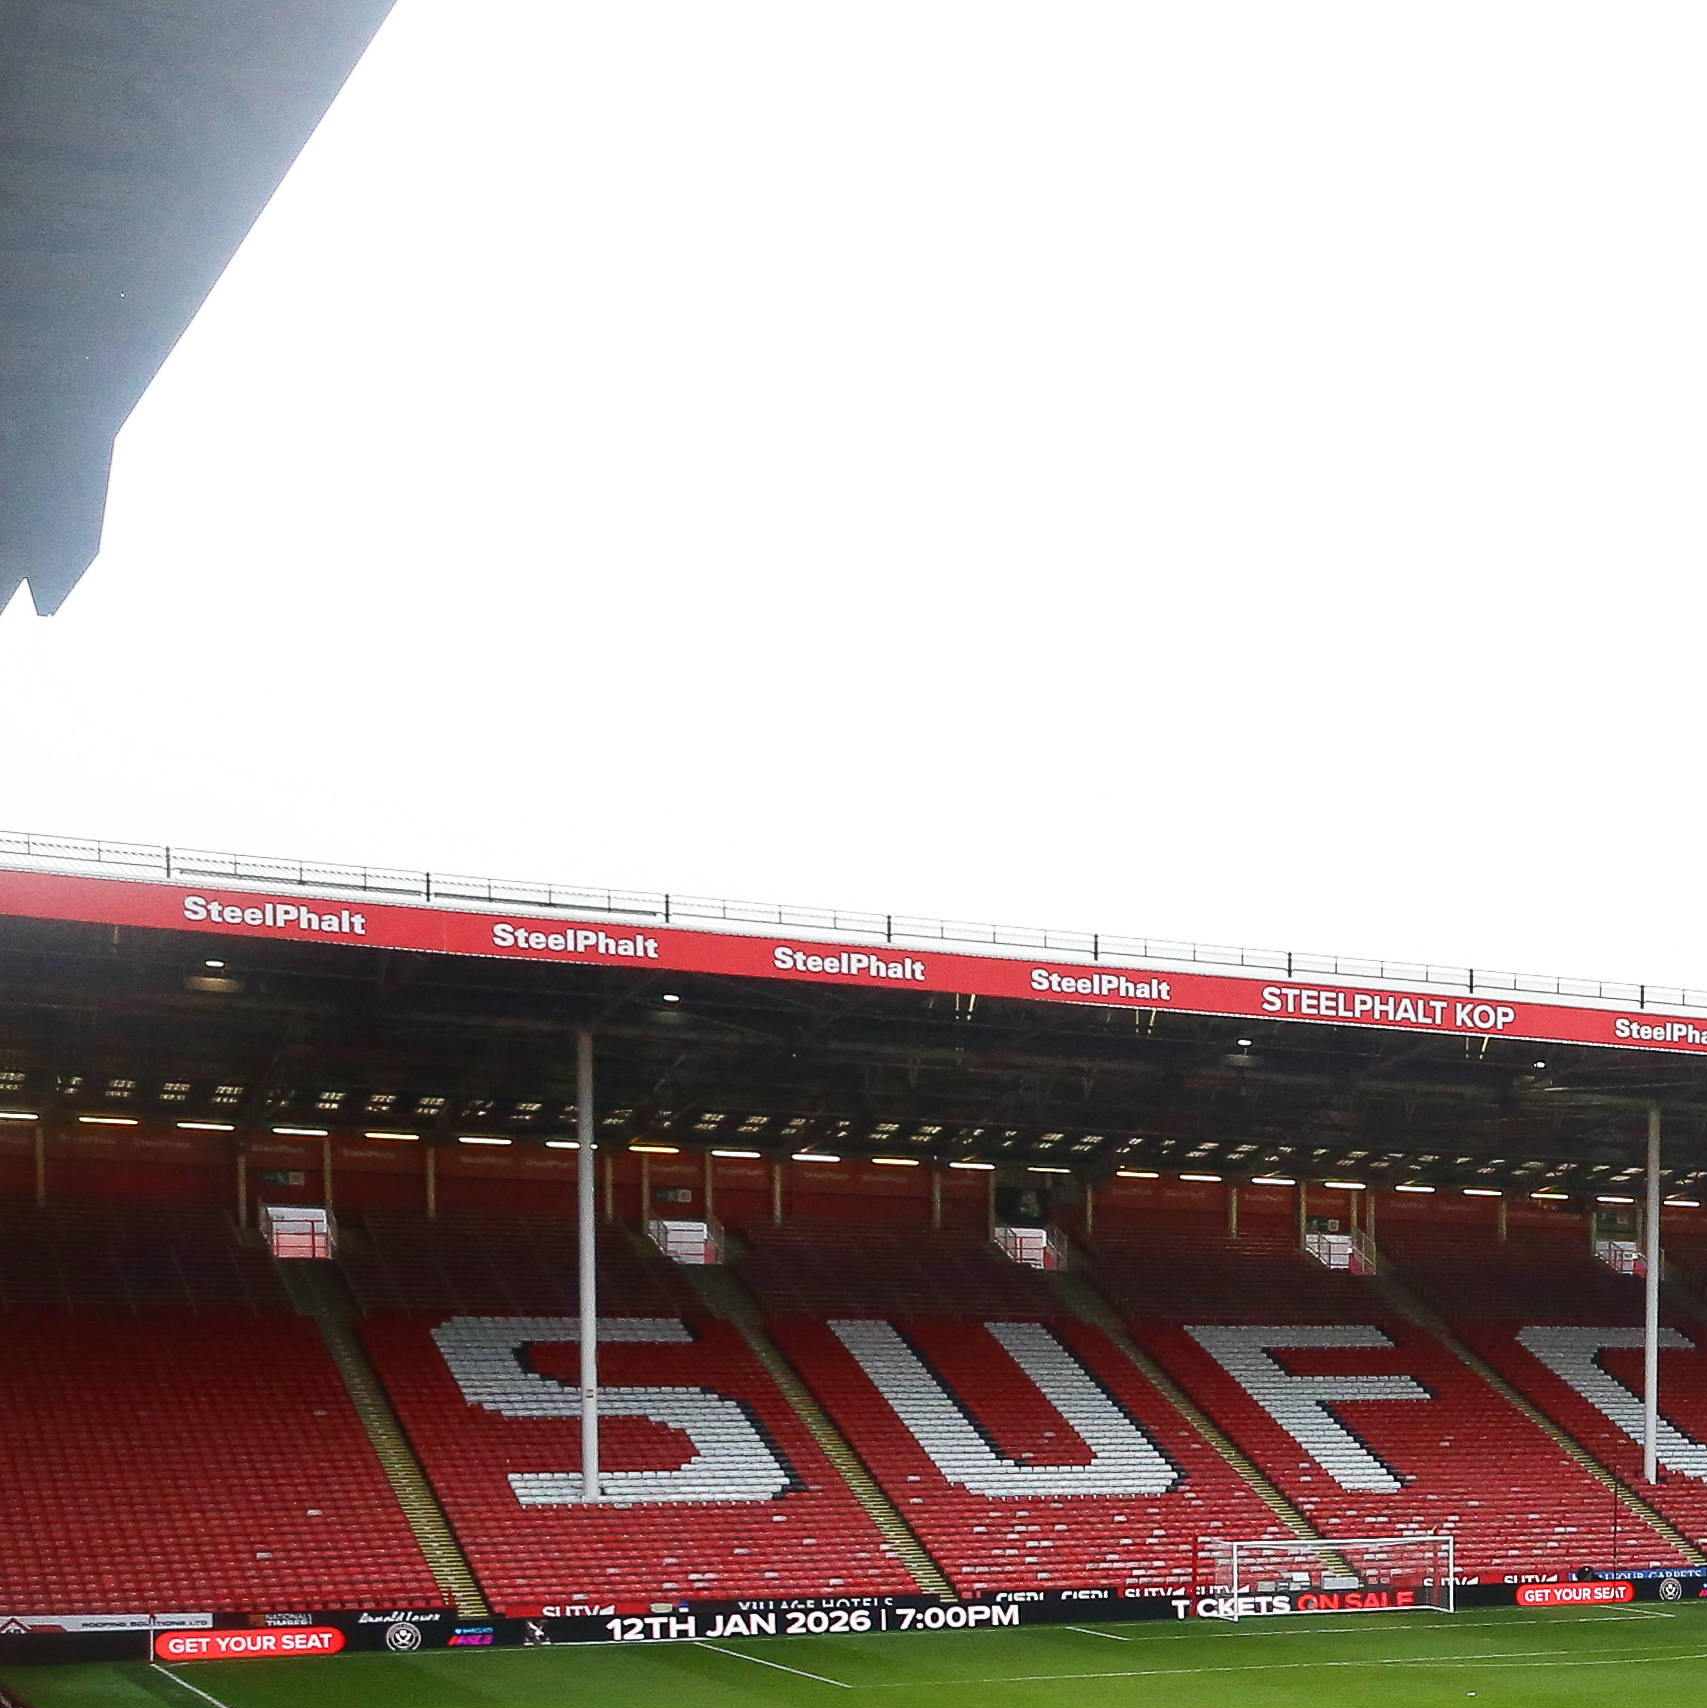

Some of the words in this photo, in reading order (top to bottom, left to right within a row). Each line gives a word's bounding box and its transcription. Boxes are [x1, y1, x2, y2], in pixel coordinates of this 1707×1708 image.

[183, 895, 366, 936] SteelPhalt
[492, 923, 659, 960] SteelPhalt
[773, 946, 925, 982] SteelPhalt
[1030, 968, 1171, 1001] SteelPhalt
[1261, 986, 1445, 1026] STEELPHALT
[1454, 1001, 1515, 1031] KOP
[1172, 1596, 1290, 1620] TCKETS
[1298, 1594, 1345, 1612] ON
[1348, 1591, 1414, 1611] SALE
[1525, 1589, 1551, 1602] GET
[1555, 1588, 1592, 1601] YOUR
[1594, 1586, 1627, 1599] SEAT
[606, 1617, 696, 1640] 12TH
[705, 1613, 776, 1638] JAN
[786, 1609, 872, 1633] 2026
[899, 1604, 1020, 1630] 7:00PM
[168, 1637, 211, 1654] GET
[216, 1635, 278, 1652] YOUR
[281, 1632, 333, 1650] SEAT
